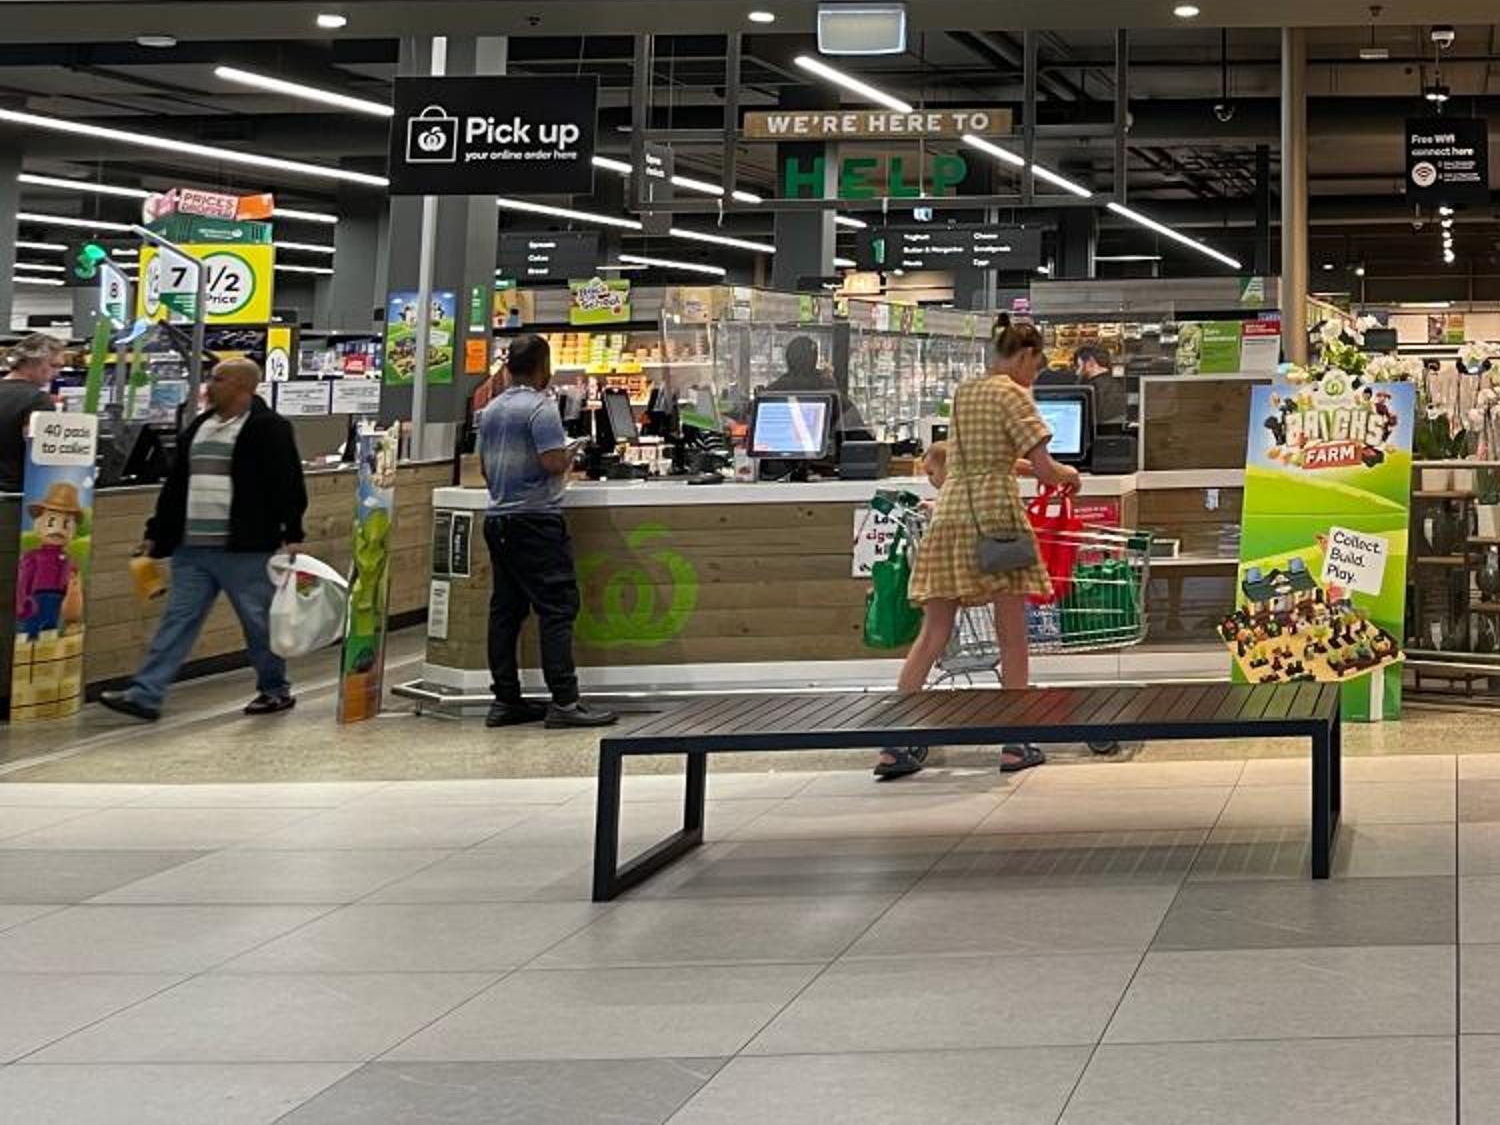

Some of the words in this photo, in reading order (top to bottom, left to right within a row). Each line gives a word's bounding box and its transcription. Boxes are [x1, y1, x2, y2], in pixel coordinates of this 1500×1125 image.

[767, 115, 856, 134] WE'RE
[868, 114, 941, 132] HERE
[953, 113, 989, 130] TO
[465, 117, 531, 143] Pick
[539, 125, 580, 150] up
[1411, 134, 1433, 144] Free
[465, 151, 489, 162] your
[490, 149, 522, 160] online
[524, 149, 552, 160] order
[553, 150, 577, 160] here
[1452, 147, 1474, 156] here
[785, 155, 967, 199] HELP
[184, 193, 234, 210] PRICES
[171, 267, 187, 287] 7
[109, 281, 119, 298] 8
[42, 443, 56, 454] to
[1305, 445, 1356, 465] FARM
